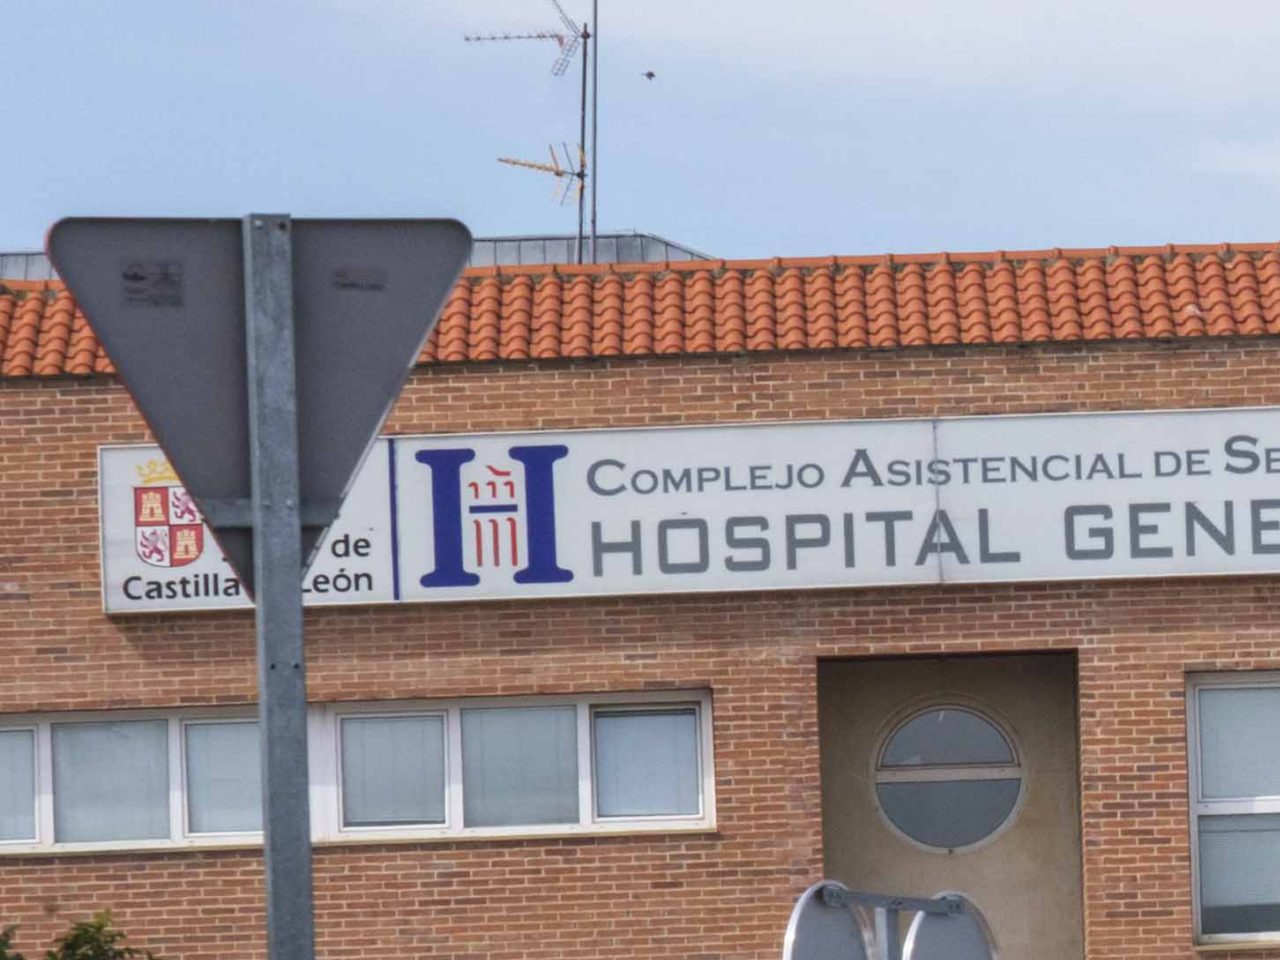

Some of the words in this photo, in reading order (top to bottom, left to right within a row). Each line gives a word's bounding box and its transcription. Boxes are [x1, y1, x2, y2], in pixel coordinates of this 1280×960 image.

[586, 458, 825, 496] COMPLEJO
[840, 448, 1142, 487] ASISTENCIAL
[1153, 449, 1211, 477] DE
[330, 534, 371, 558] de
[591, 508, 1021, 577] HOSPITAL
[123, 573, 240, 600] Castilla
